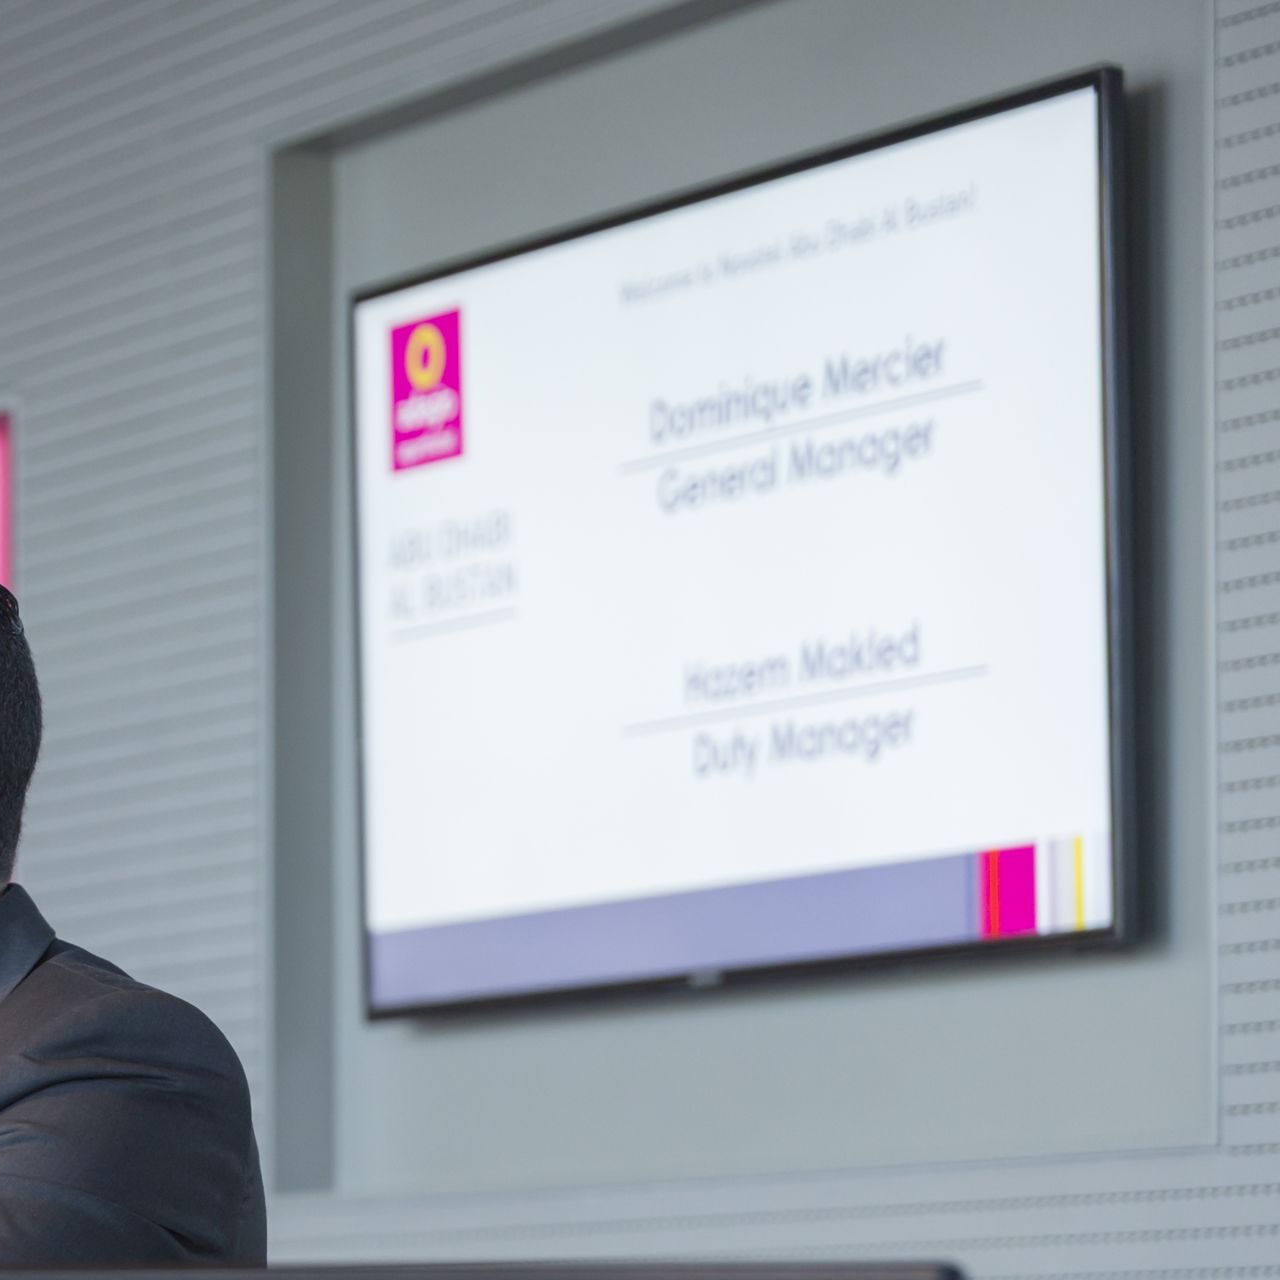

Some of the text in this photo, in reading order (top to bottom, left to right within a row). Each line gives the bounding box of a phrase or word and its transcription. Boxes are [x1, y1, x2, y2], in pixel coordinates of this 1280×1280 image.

[650, 334, 945, 442] Dominique Mercier
[658, 418, 935, 512] General Manager
[684, 618, 922, 702] Hazem Makled
[694, 709, 915, 783] Duty Manager
